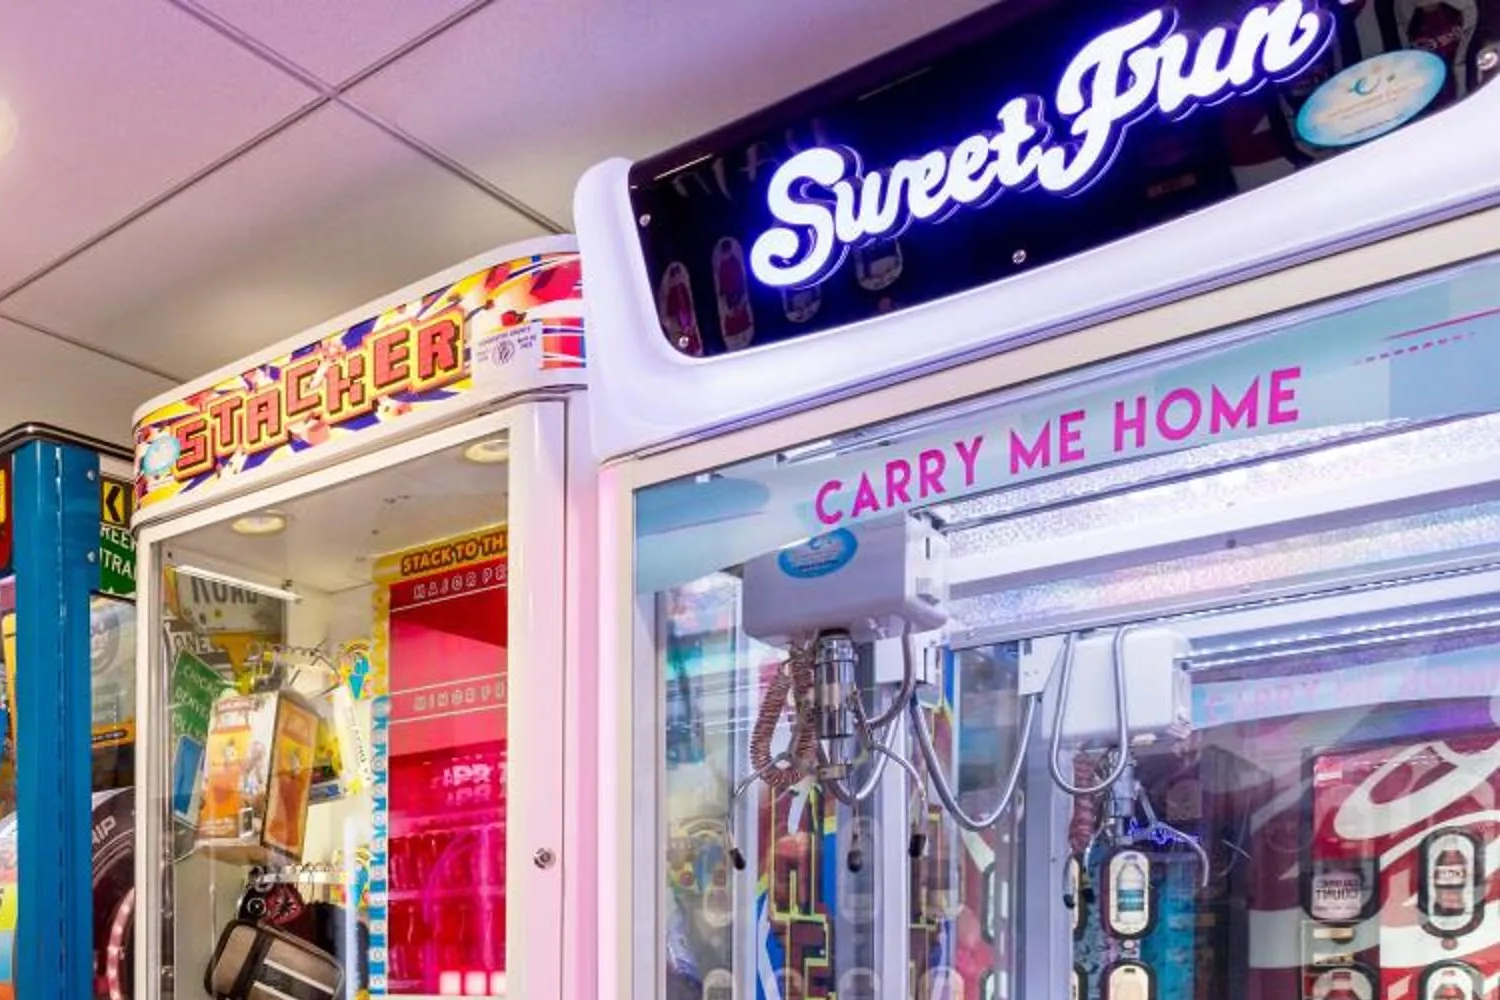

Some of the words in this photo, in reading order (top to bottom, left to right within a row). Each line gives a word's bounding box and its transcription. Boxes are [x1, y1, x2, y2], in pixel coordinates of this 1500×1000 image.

[750, 96, 1040, 286] Sweet
[174, 312, 462, 476] STACKER
[814, 434, 984, 526] CARRY
[1009, 410, 1086, 476] ME
[1113, 366, 1302, 453] HOME
[402, 546, 453, 575] STACK
[454, 538, 479, 560] TO
